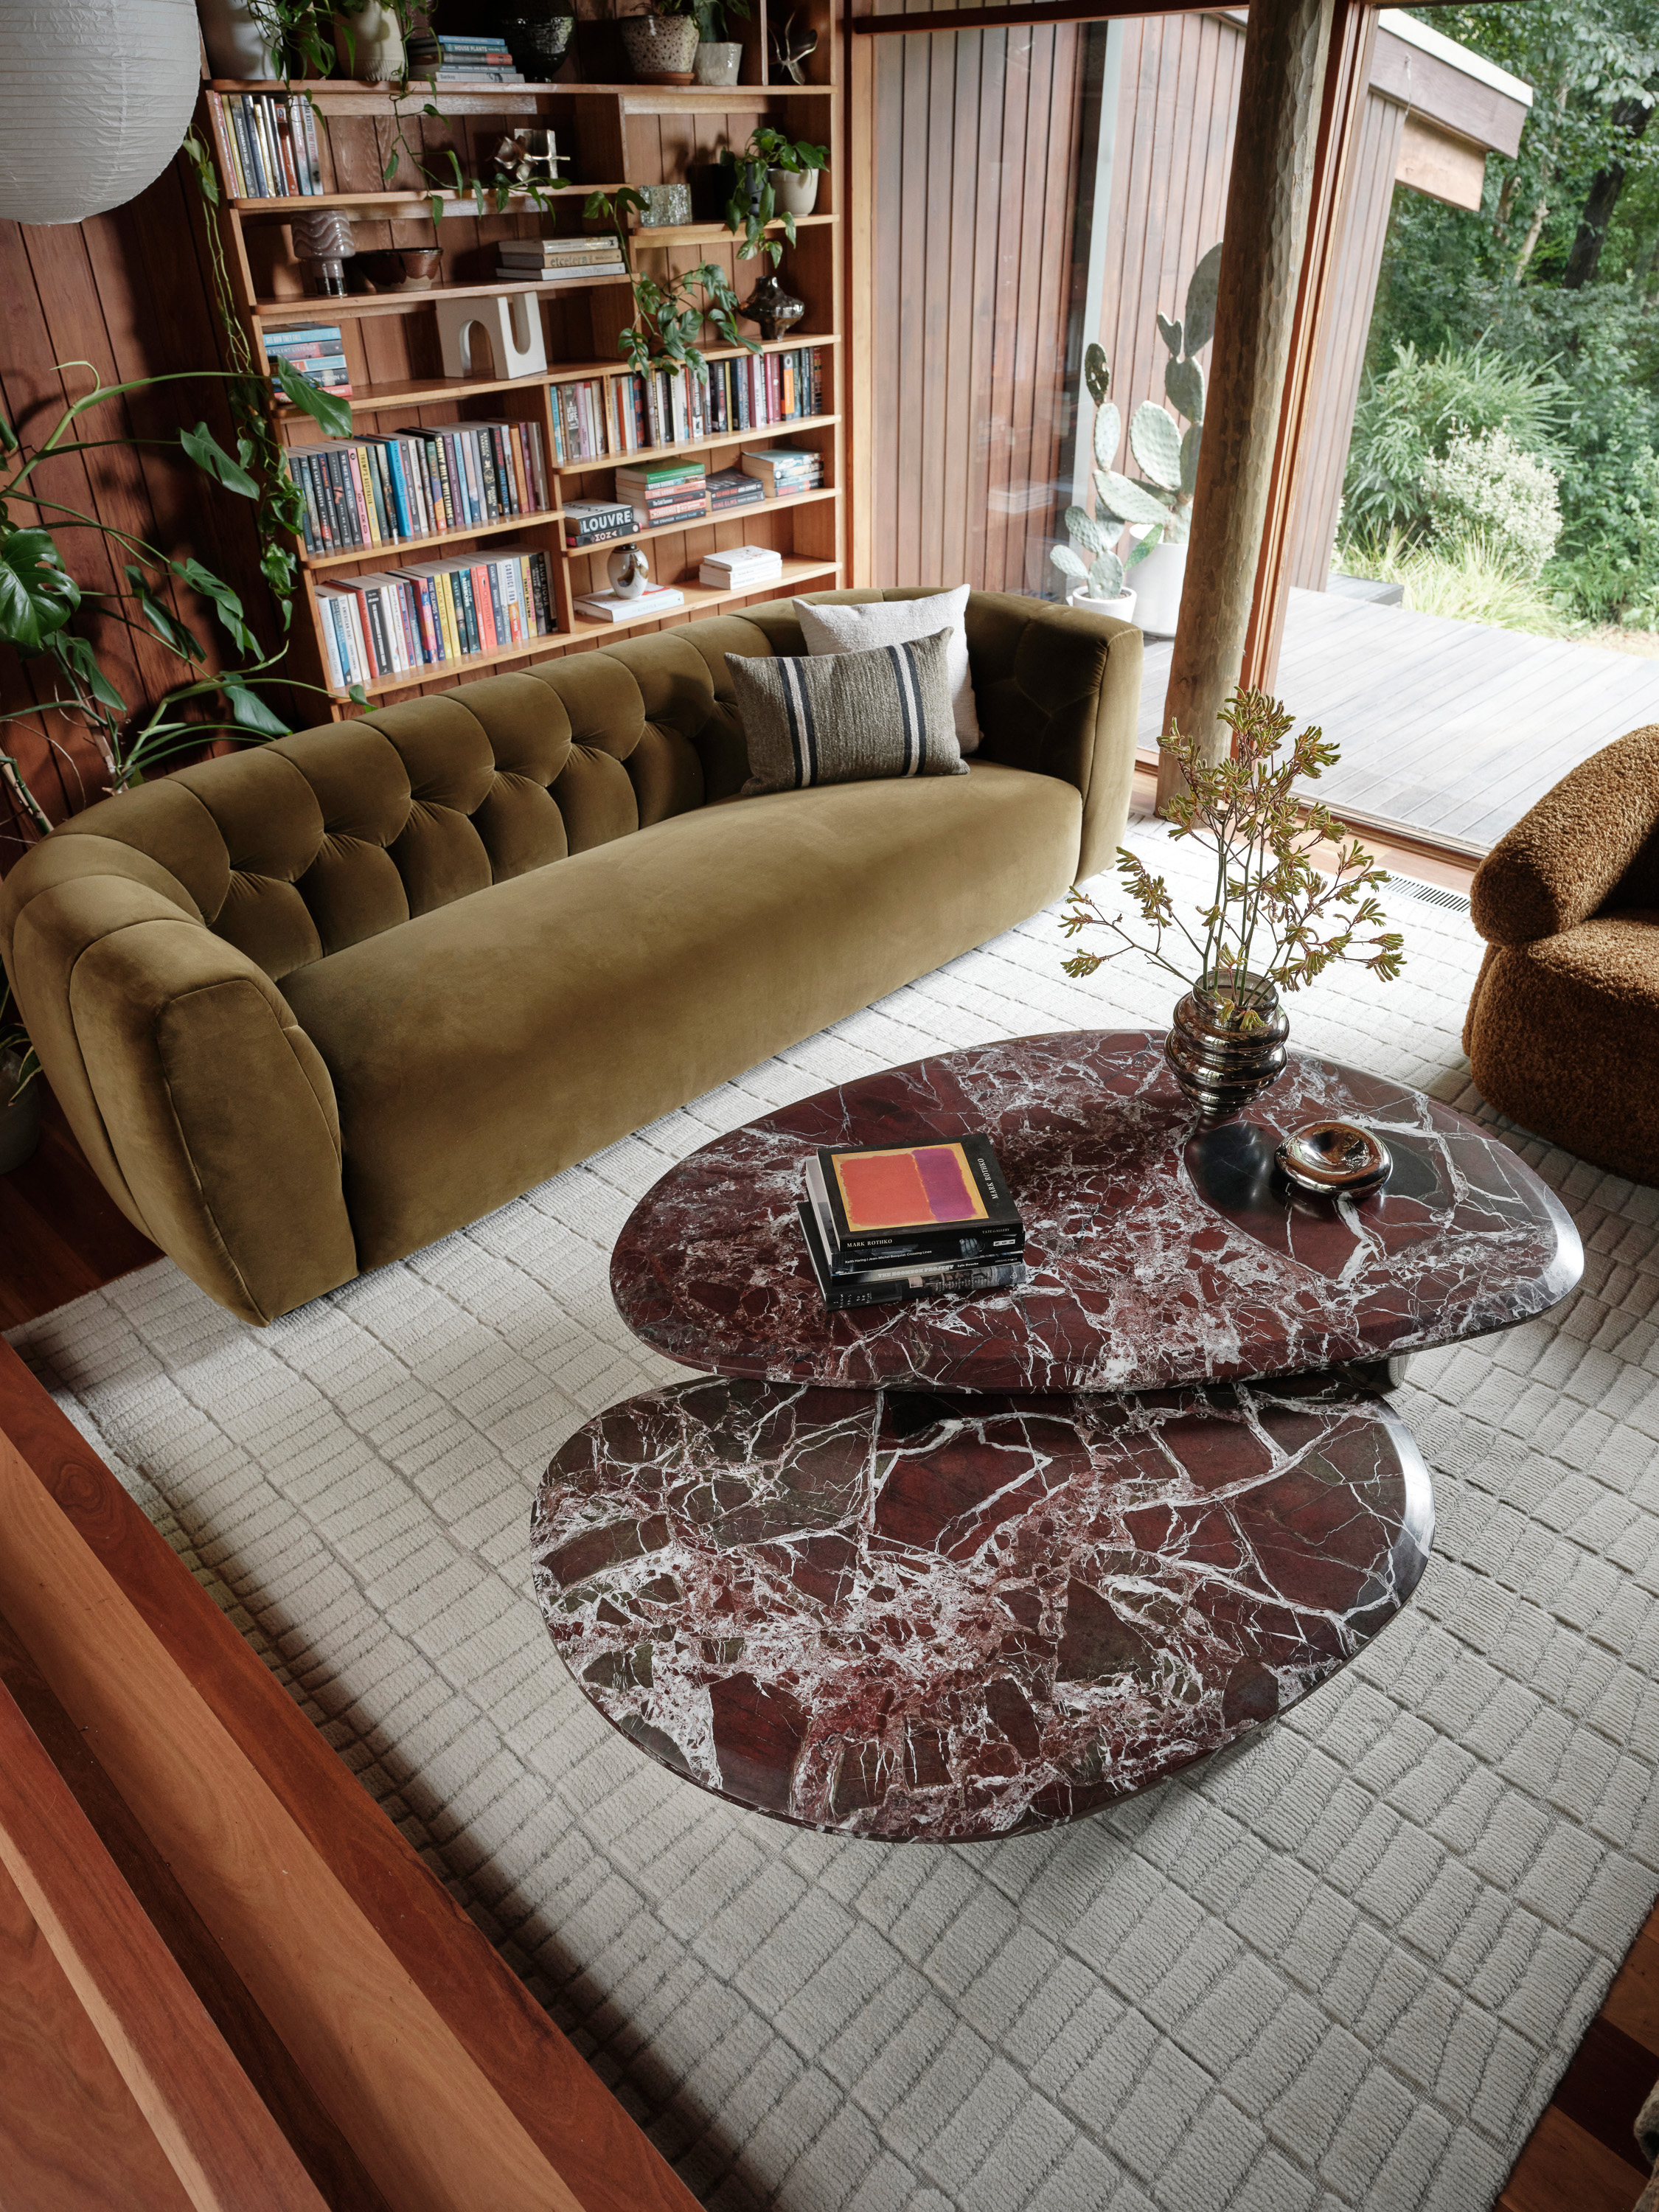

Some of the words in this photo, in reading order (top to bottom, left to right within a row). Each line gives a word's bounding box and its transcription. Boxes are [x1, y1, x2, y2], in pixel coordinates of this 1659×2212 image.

[567, 412, 578, 422] LIFE
[434, 437, 445, 462] SONNY
[359, 454, 368, 476] TRUMP'S
[381, 465, 391, 486] Others
[429, 455, 438, 481] FORTY
[439, 465, 447, 481] BILL
[316, 486, 324, 506] GUESTS
[363, 478, 373, 504] AUSTRALIA
[441, 482, 453, 518] WILLIAMS
[582, 510, 631, 533] LOUVRE
[505, 564, 514, 588] CANDICE
[429, 592, 438, 613] ISLANDS
[461, 577, 470, 607] MIRRORS
[482, 590, 492, 629] OUTSIDER
[978, 1158, 991, 1180] ROTHKO
[987, 1182, 999, 1199] MARK
